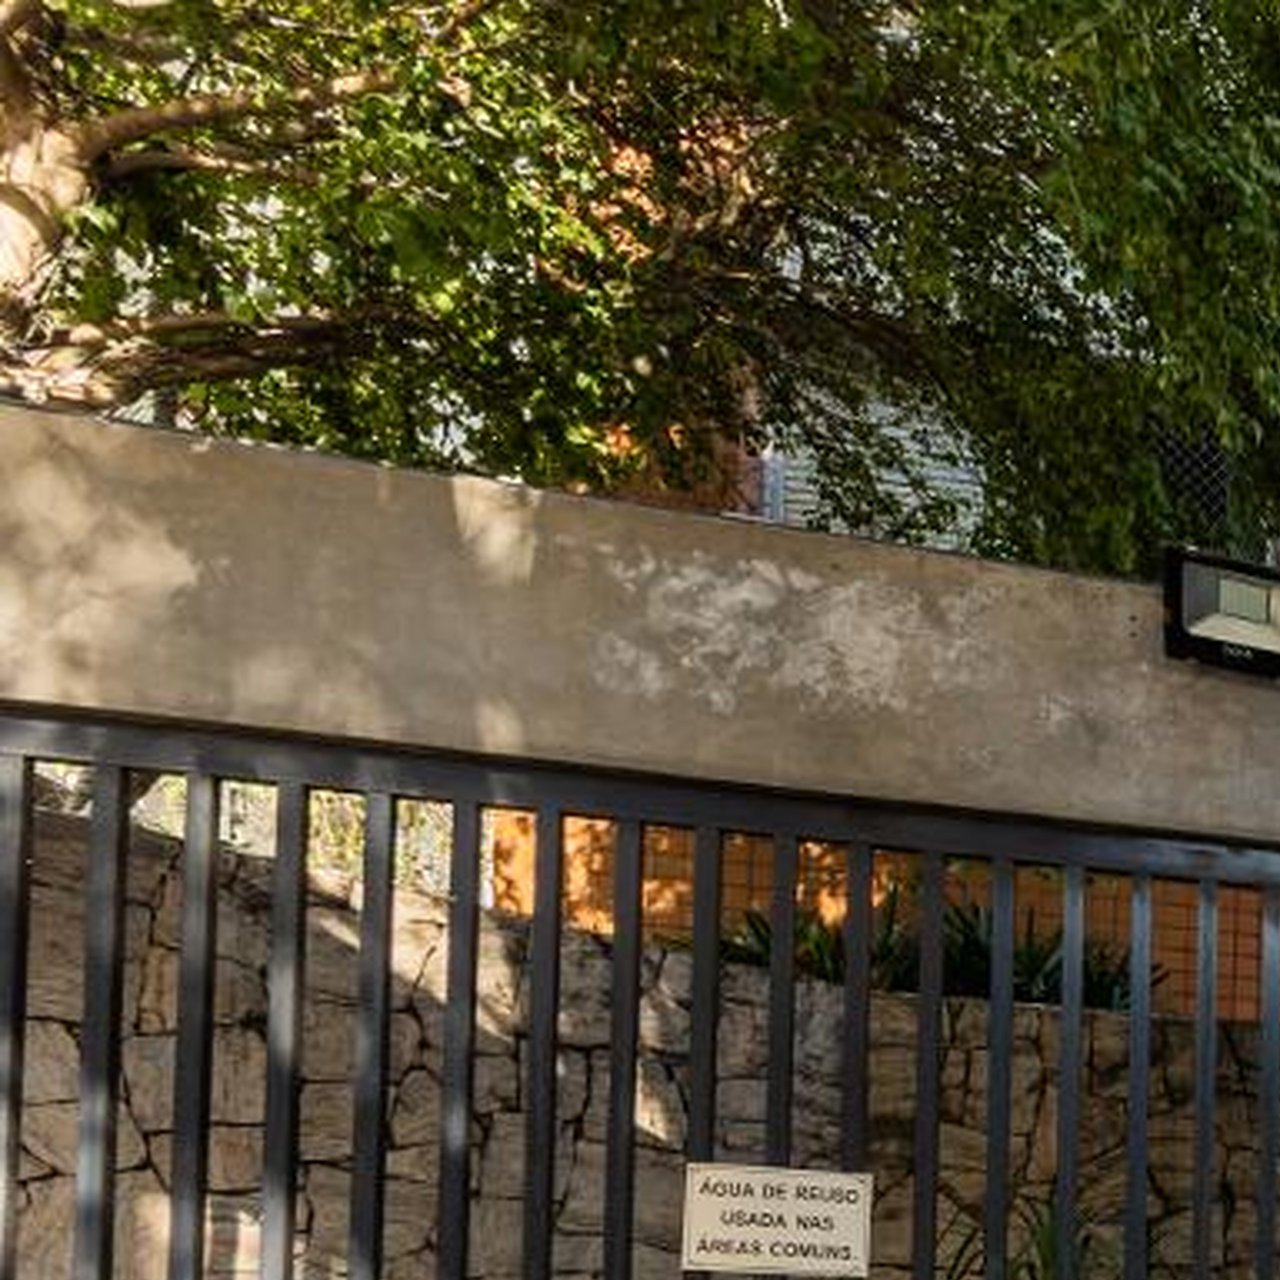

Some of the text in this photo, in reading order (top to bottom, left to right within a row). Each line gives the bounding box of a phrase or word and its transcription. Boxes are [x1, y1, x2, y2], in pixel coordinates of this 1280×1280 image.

[699, 1176, 860, 1204] ÁGUA DE REUSO
[719, 1209, 835, 1231] USADA NAS
